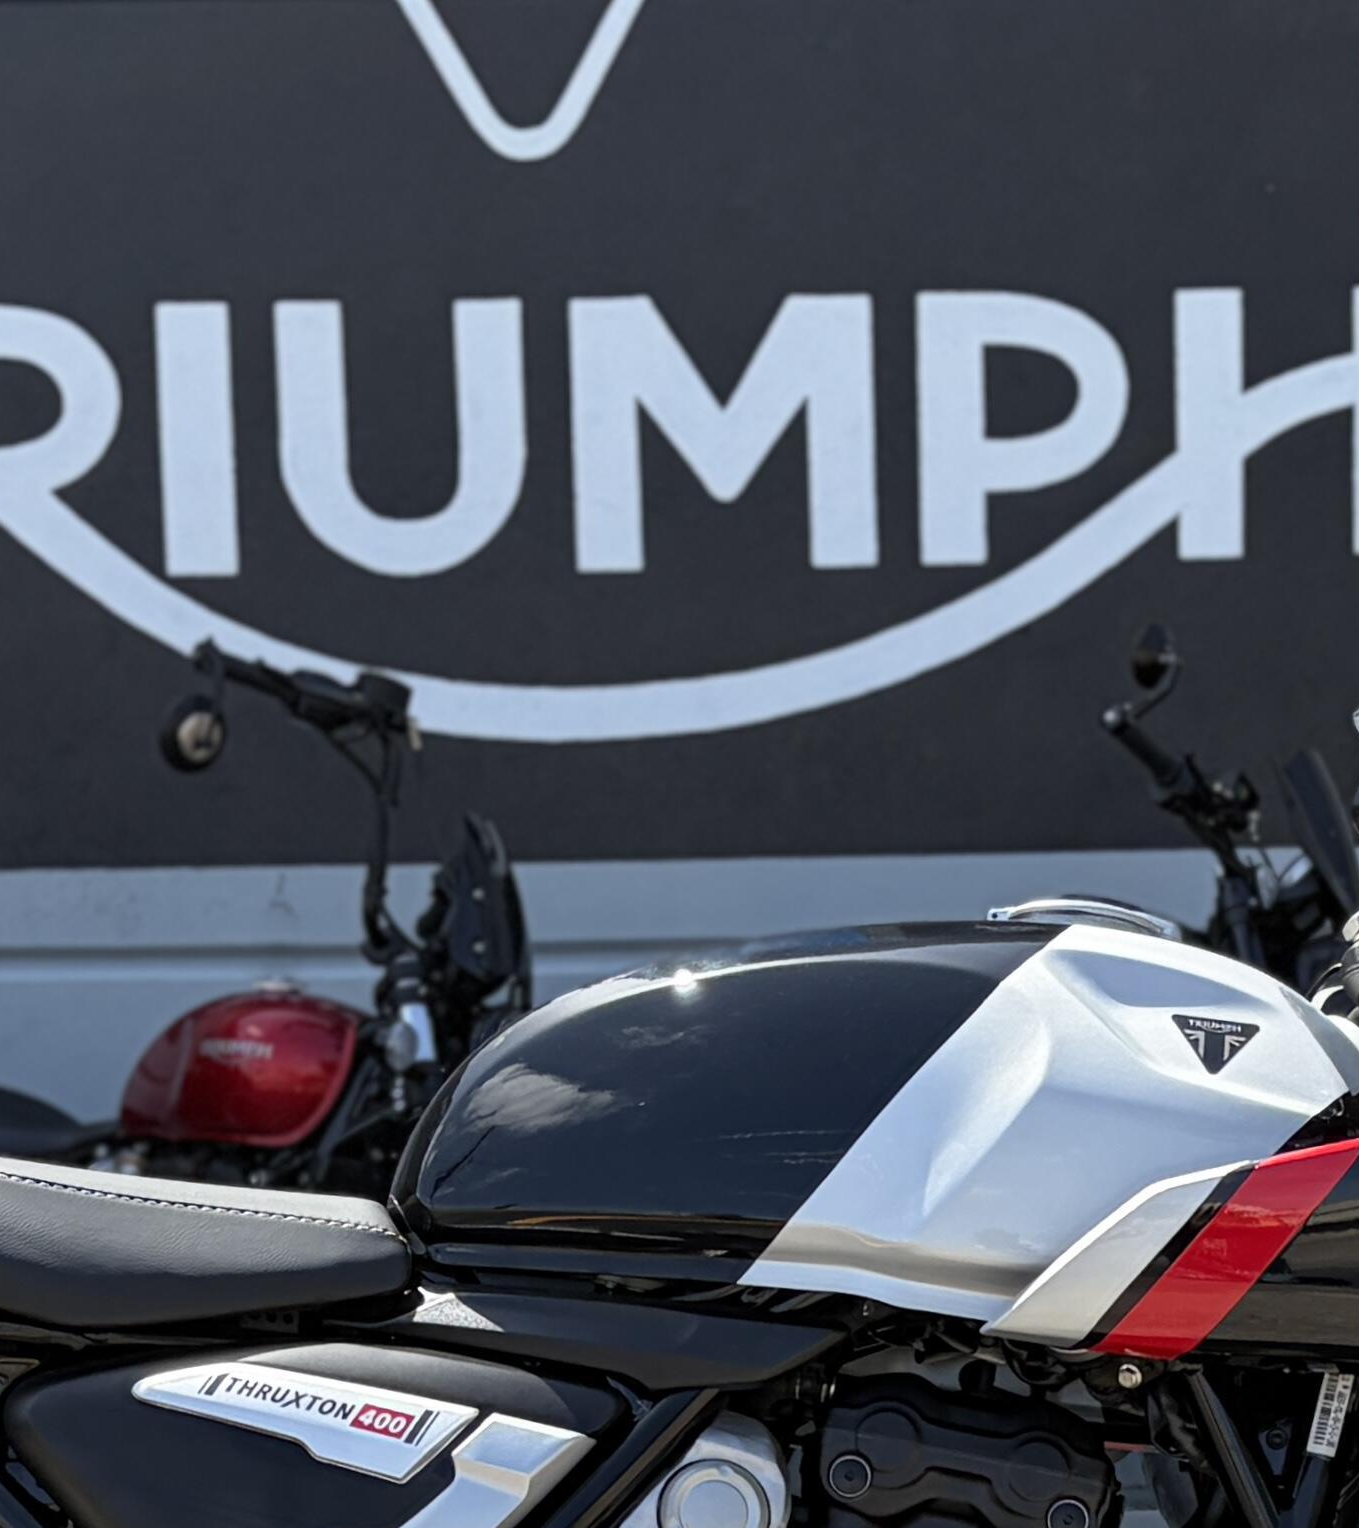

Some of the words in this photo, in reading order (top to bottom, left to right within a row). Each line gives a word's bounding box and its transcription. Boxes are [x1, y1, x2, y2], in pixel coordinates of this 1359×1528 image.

[1188, 1018, 1242, 1033] TRIUMPH
[225, 1377, 356, 1421] THRUXTON
[358, 1408, 408, 1434] 400
